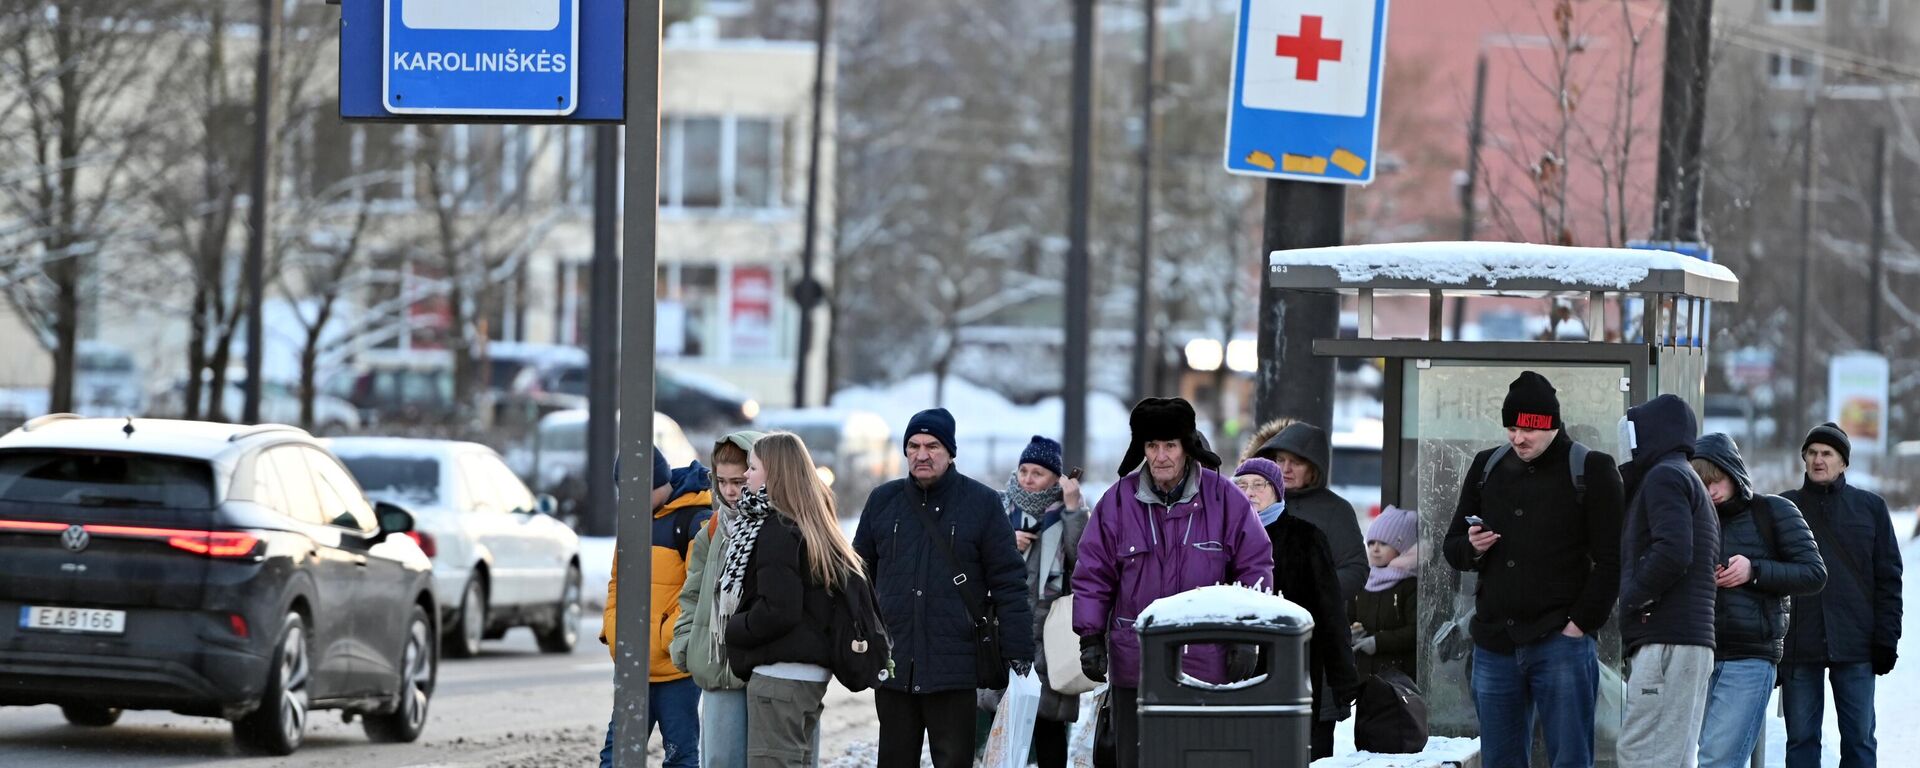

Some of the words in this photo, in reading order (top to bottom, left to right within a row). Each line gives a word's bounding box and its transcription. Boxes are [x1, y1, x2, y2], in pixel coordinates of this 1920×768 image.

[393, 48, 567, 73] KAROLINIŠKĖS
[1515, 411, 1553, 430] AMSTERDAM
[39, 608, 114, 629] EA8166
